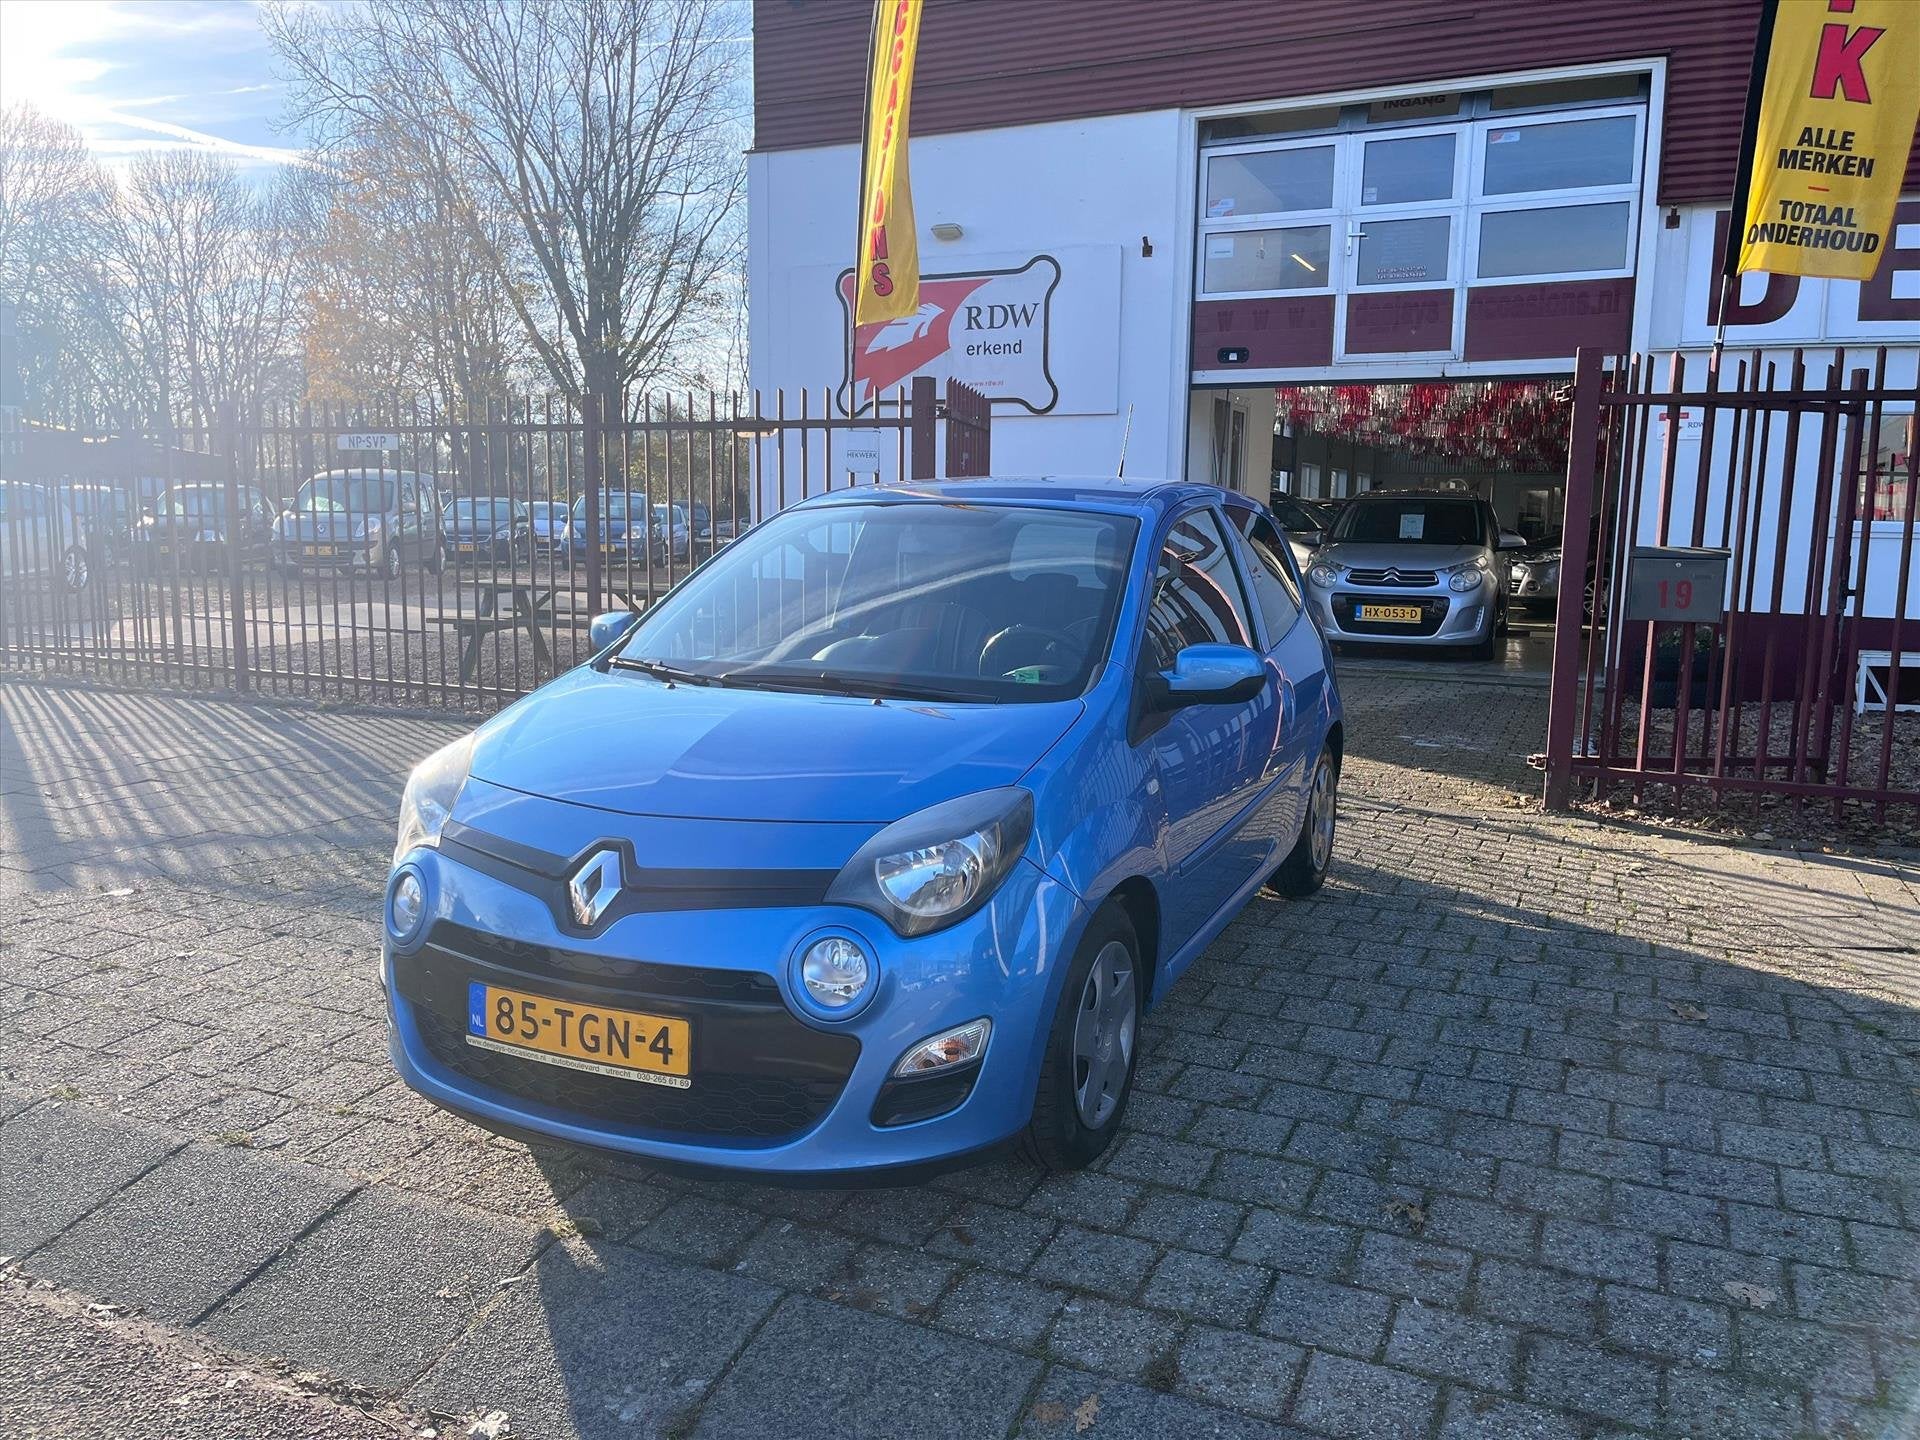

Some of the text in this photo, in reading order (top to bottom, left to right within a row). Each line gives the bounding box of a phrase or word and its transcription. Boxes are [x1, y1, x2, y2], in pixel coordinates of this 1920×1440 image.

[1797, 126, 1855, 151] ALLE
[1777, 148, 1875, 178] MERKEN
[1778, 200, 1857, 228] TOTAAL
[1746, 223, 1880, 254] ONDERHOUD
[964, 303, 1040, 330] RDW
[966, 339, 1022, 356] erkend
[1657, 580, 1693, 609] 19
[1364, 607, 1417, 619] HX-053-D
[471, 1013, 484, 1028] NL
[495, 996, 674, 1066] 85-TGN-4
[605, 1067, 631, 1078] utrecht
[636, 1072, 667, 1085] 030-265
[668, 1077, 678, 1087] 61
[679, 1079, 690, 1089] 69
